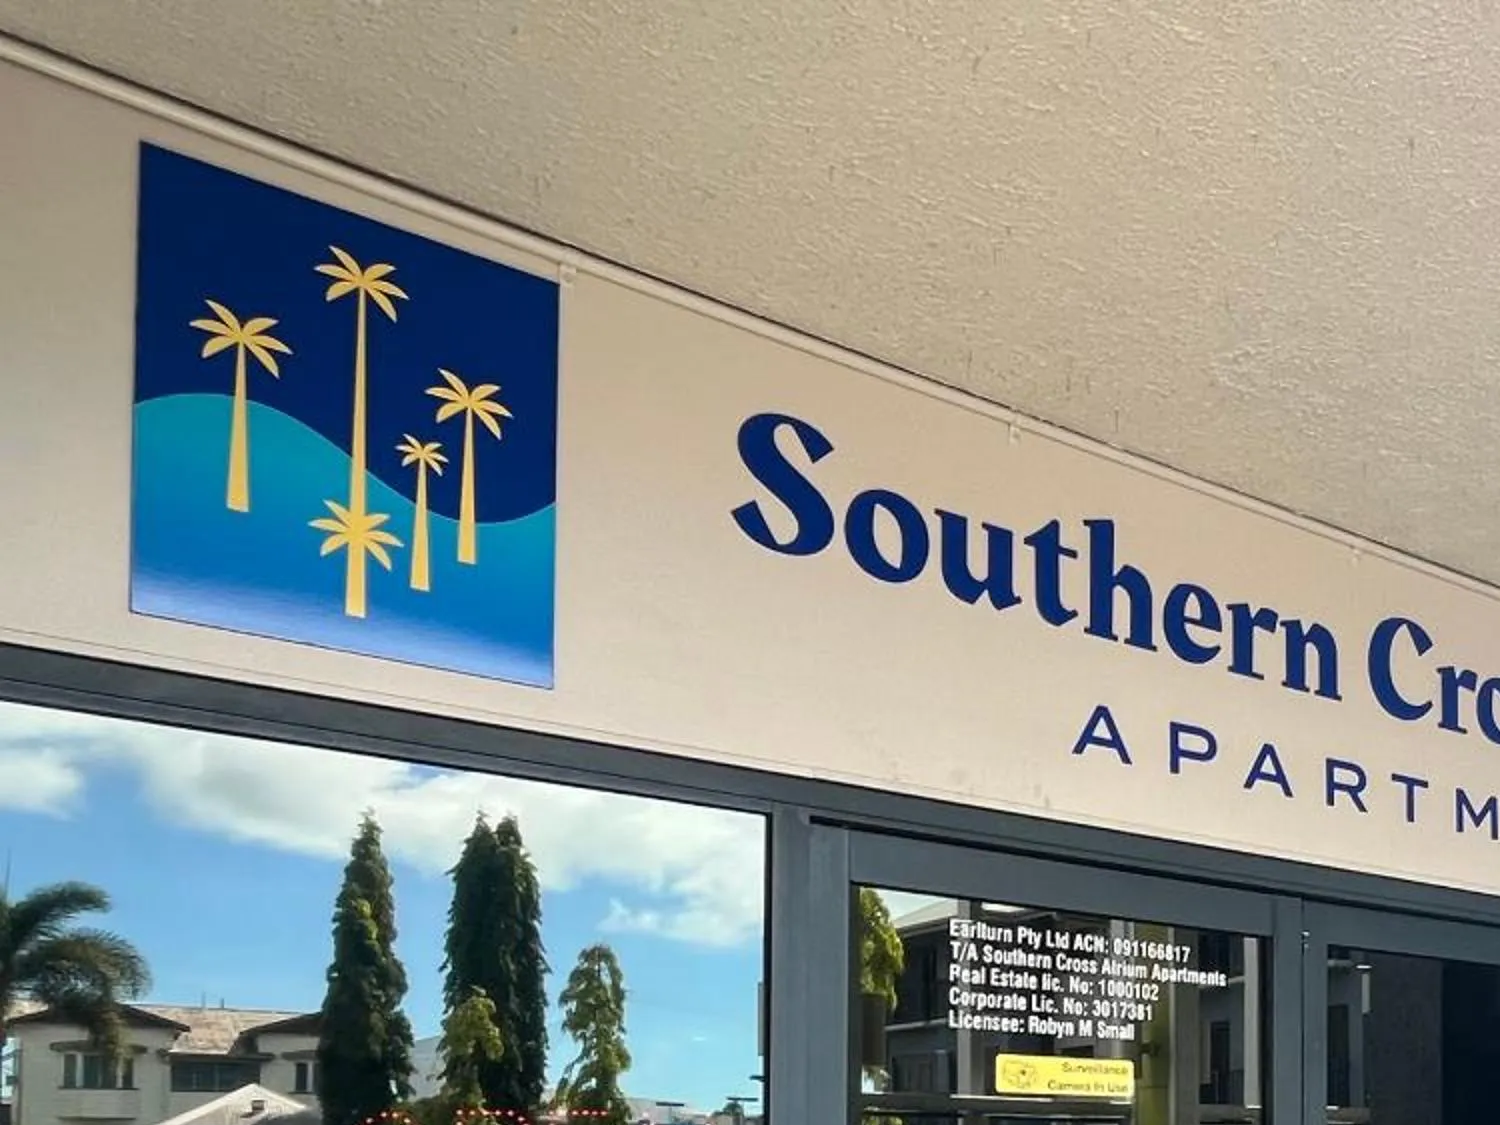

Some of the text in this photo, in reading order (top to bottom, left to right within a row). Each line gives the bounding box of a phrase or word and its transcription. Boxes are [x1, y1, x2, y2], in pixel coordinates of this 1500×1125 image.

[731, 414, 1342, 700] Southern
[1018, 926, 1041, 950] Pty
[1046, 929, 1069, 949] Ltd
[1073, 933, 1109, 954] ACN:
[949, 963, 986, 985] Real
[990, 967, 1038, 990] Estate
[1069, 976, 1093, 996] No:
[950, 941, 1227, 987] T/A Southern Cross Atrium Apartments
[949, 986, 1027, 1011] Corporate
[1031, 993, 1059, 1013] Lic.
[1063, 996, 1089, 1017] No:
[948, 1009, 1135, 1041] Licensee: Robyn M Small
[1047, 1079, 1091, 1091] Camera
